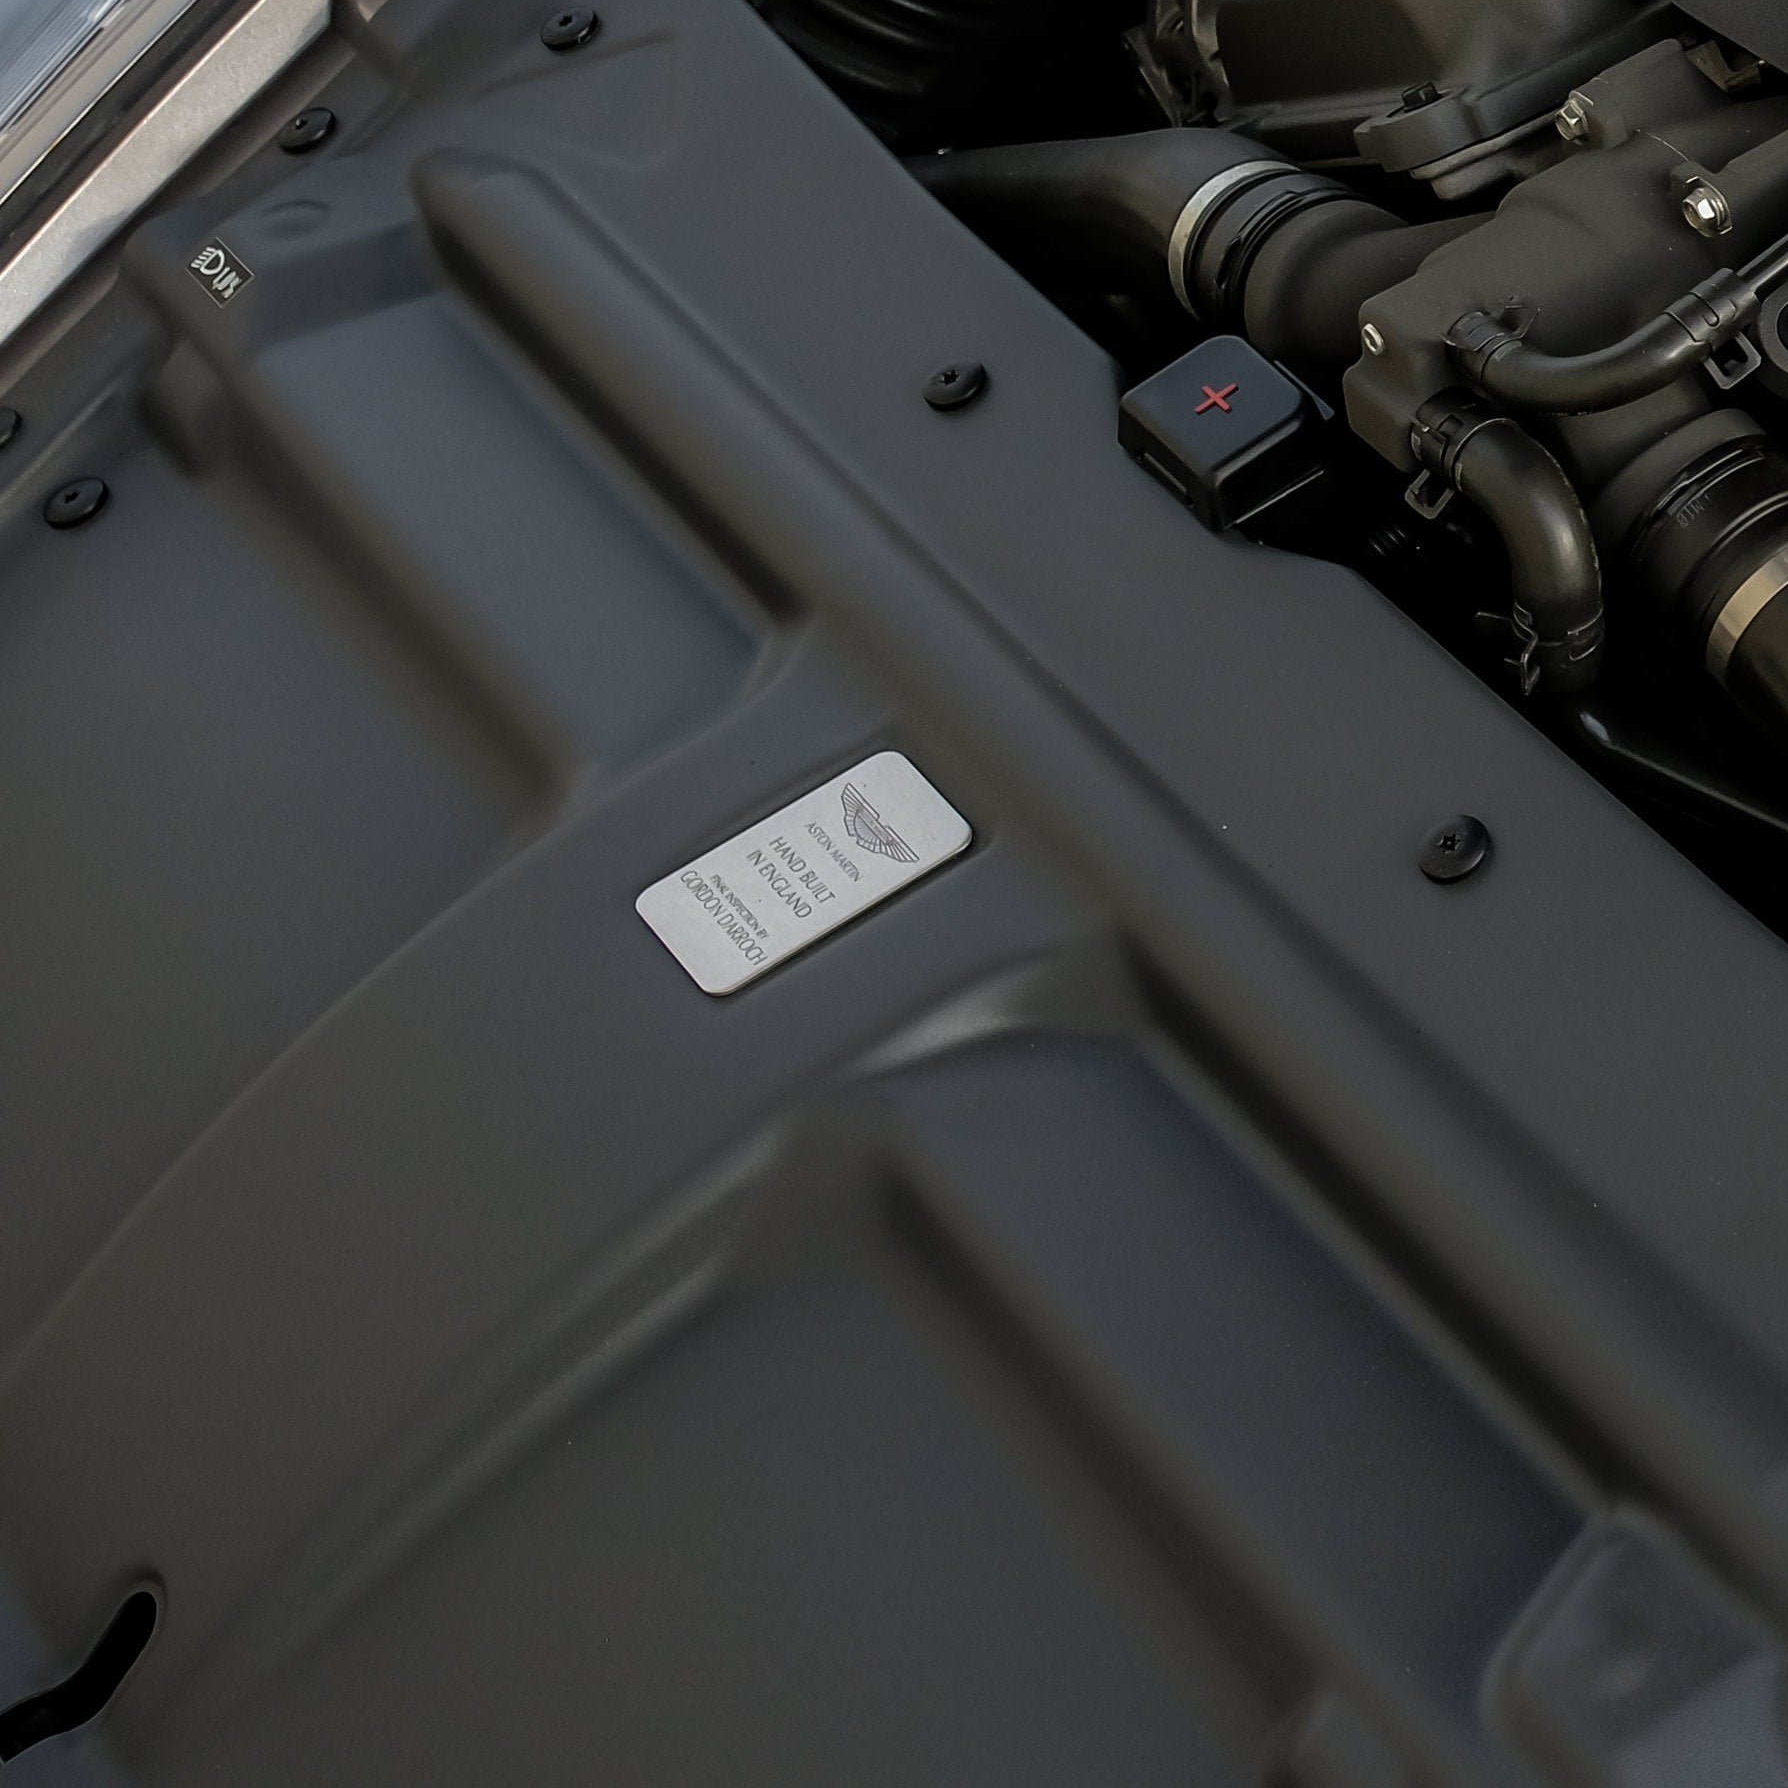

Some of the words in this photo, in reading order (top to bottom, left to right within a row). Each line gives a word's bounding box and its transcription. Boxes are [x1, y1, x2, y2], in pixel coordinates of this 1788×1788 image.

[746, 848, 767, 867] IN
[758, 862, 812, 918] ENGLAND
[768, 836, 807, 873] HAND
[799, 870, 836, 904] BUILT
[804, 822, 834, 851] ASTON
[829, 849, 862, 882] MARTIN
[680, 870, 728, 918] GORDON
[716, 913, 768, 966] DARROCH
[756, 928, 770, 939] BY
